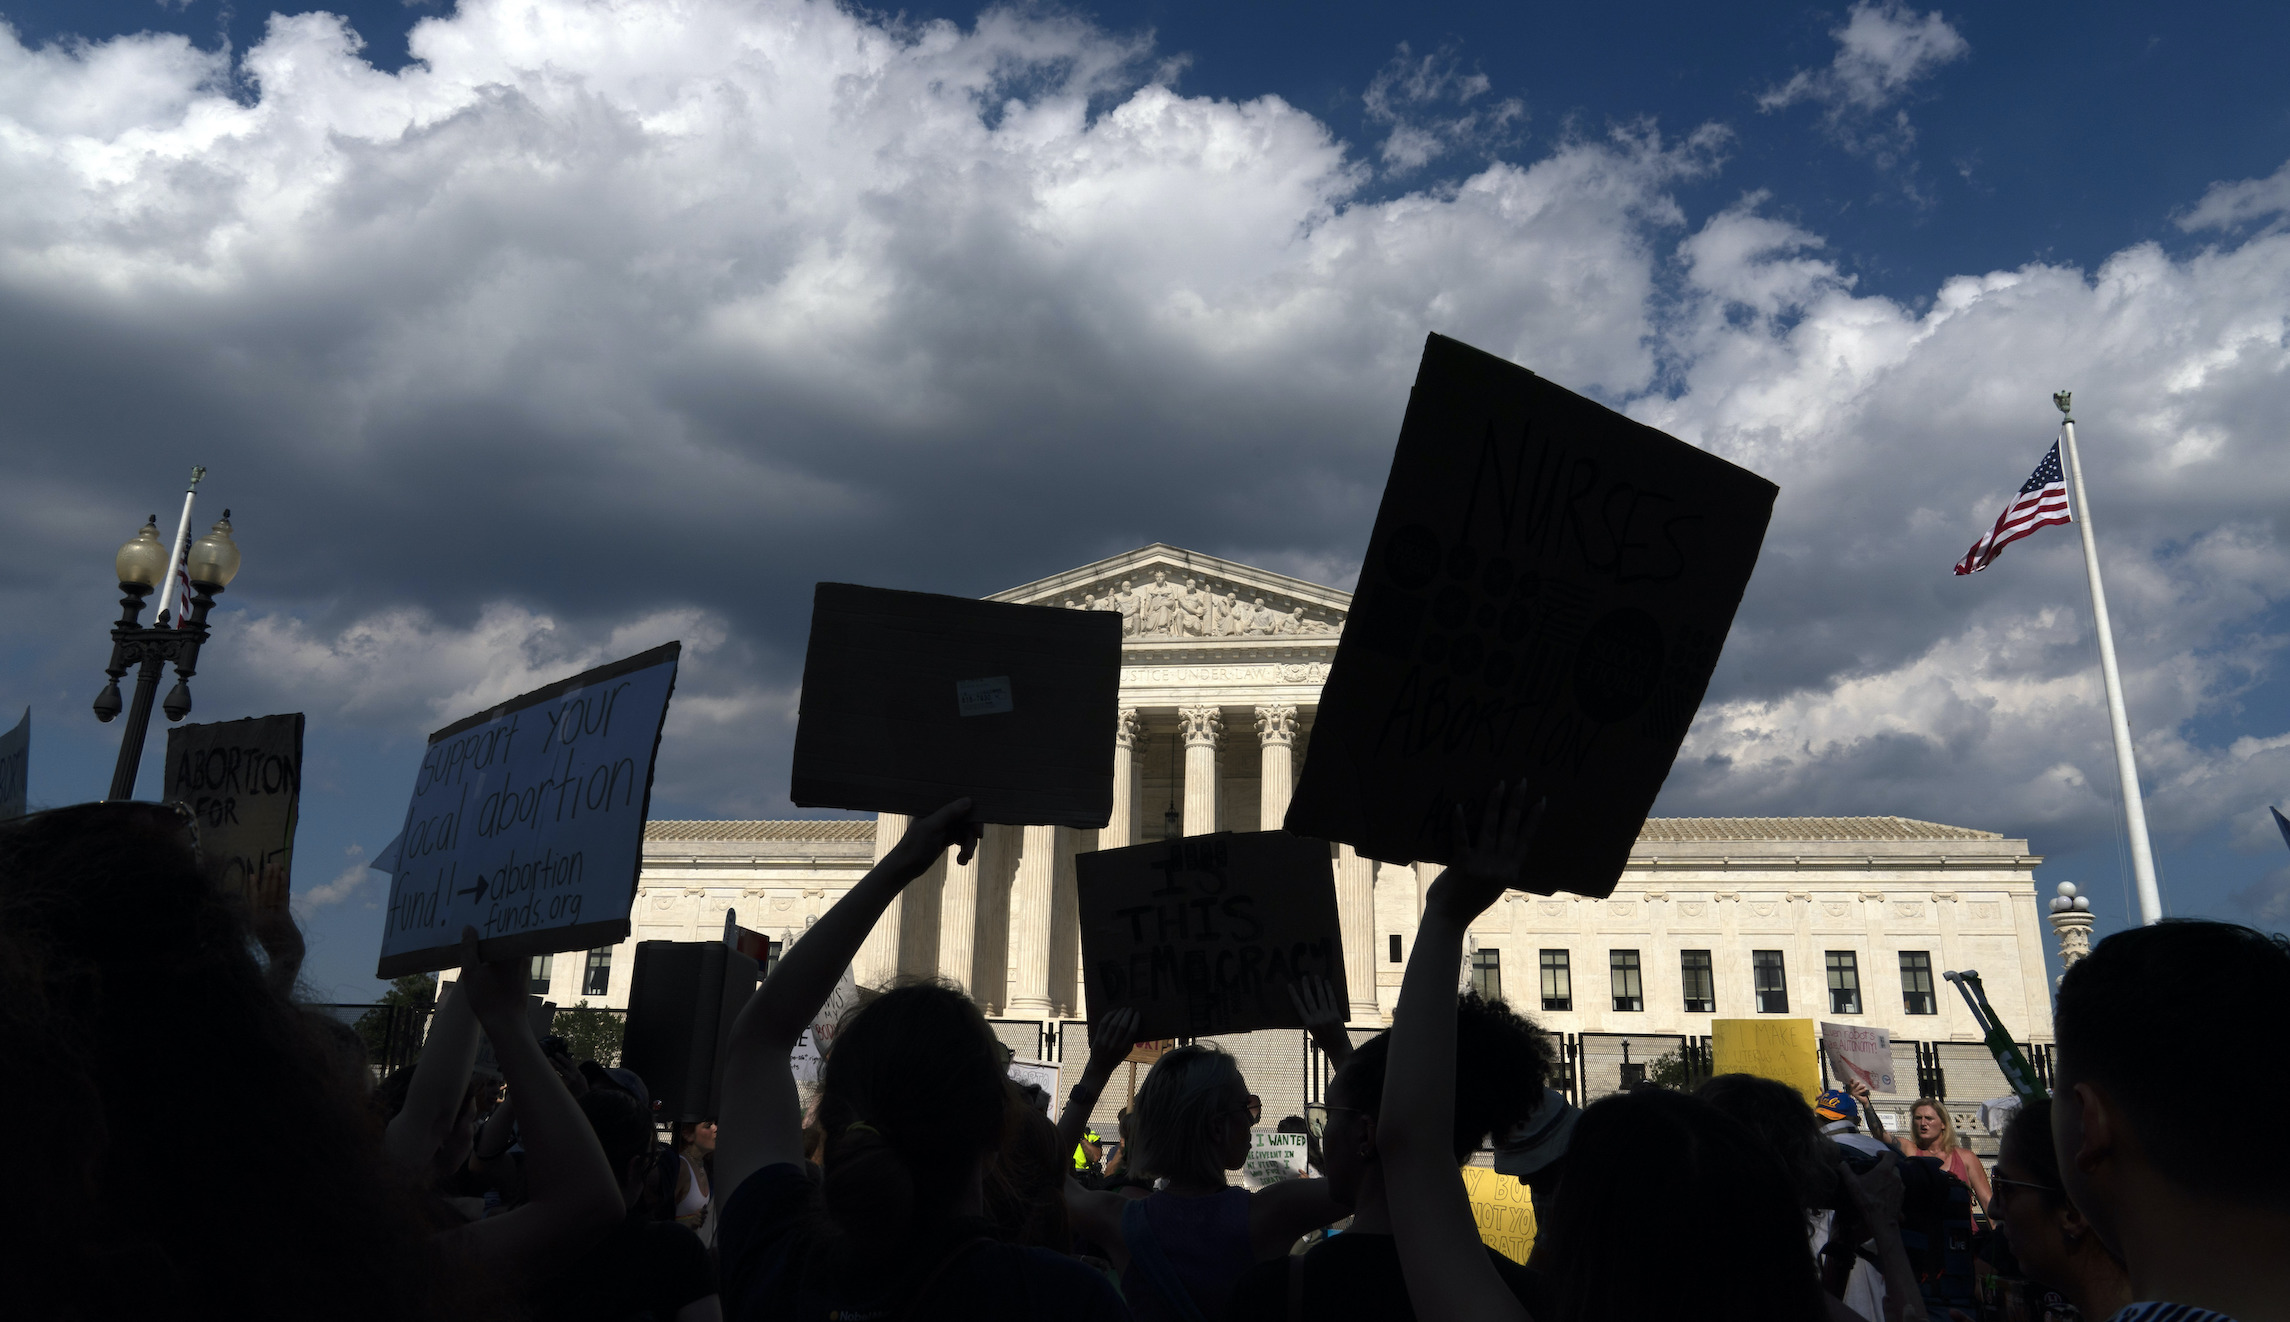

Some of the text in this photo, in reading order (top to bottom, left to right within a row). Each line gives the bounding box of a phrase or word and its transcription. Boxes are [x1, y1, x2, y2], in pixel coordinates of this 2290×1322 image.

[1459, 419, 1703, 585] NURSES
[1120, 668, 1266, 682] USTICE UNDER LAW
[543, 682, 631, 754] your
[1372, 665, 1604, 777] ABORTION
[176, 746, 300, 796] ABORTION
[195, 797, 240, 828] FOR
[398, 748, 634, 872] local abortion
[389, 849, 583, 939] fund! abortion
[484, 893, 582, 940] funds.org
[1112, 895, 1264, 943] THIS
[1098, 937, 1333, 1004] DEMOCRACY
[1755, 1024, 1799, 1048] MAKE
[1778, 1050, 1787, 1063] A
[1843, 1027, 1876, 1040] robots
[1256, 1133, 1307, 1147] I WANTED
[1284, 1160, 1290, 1169] I
